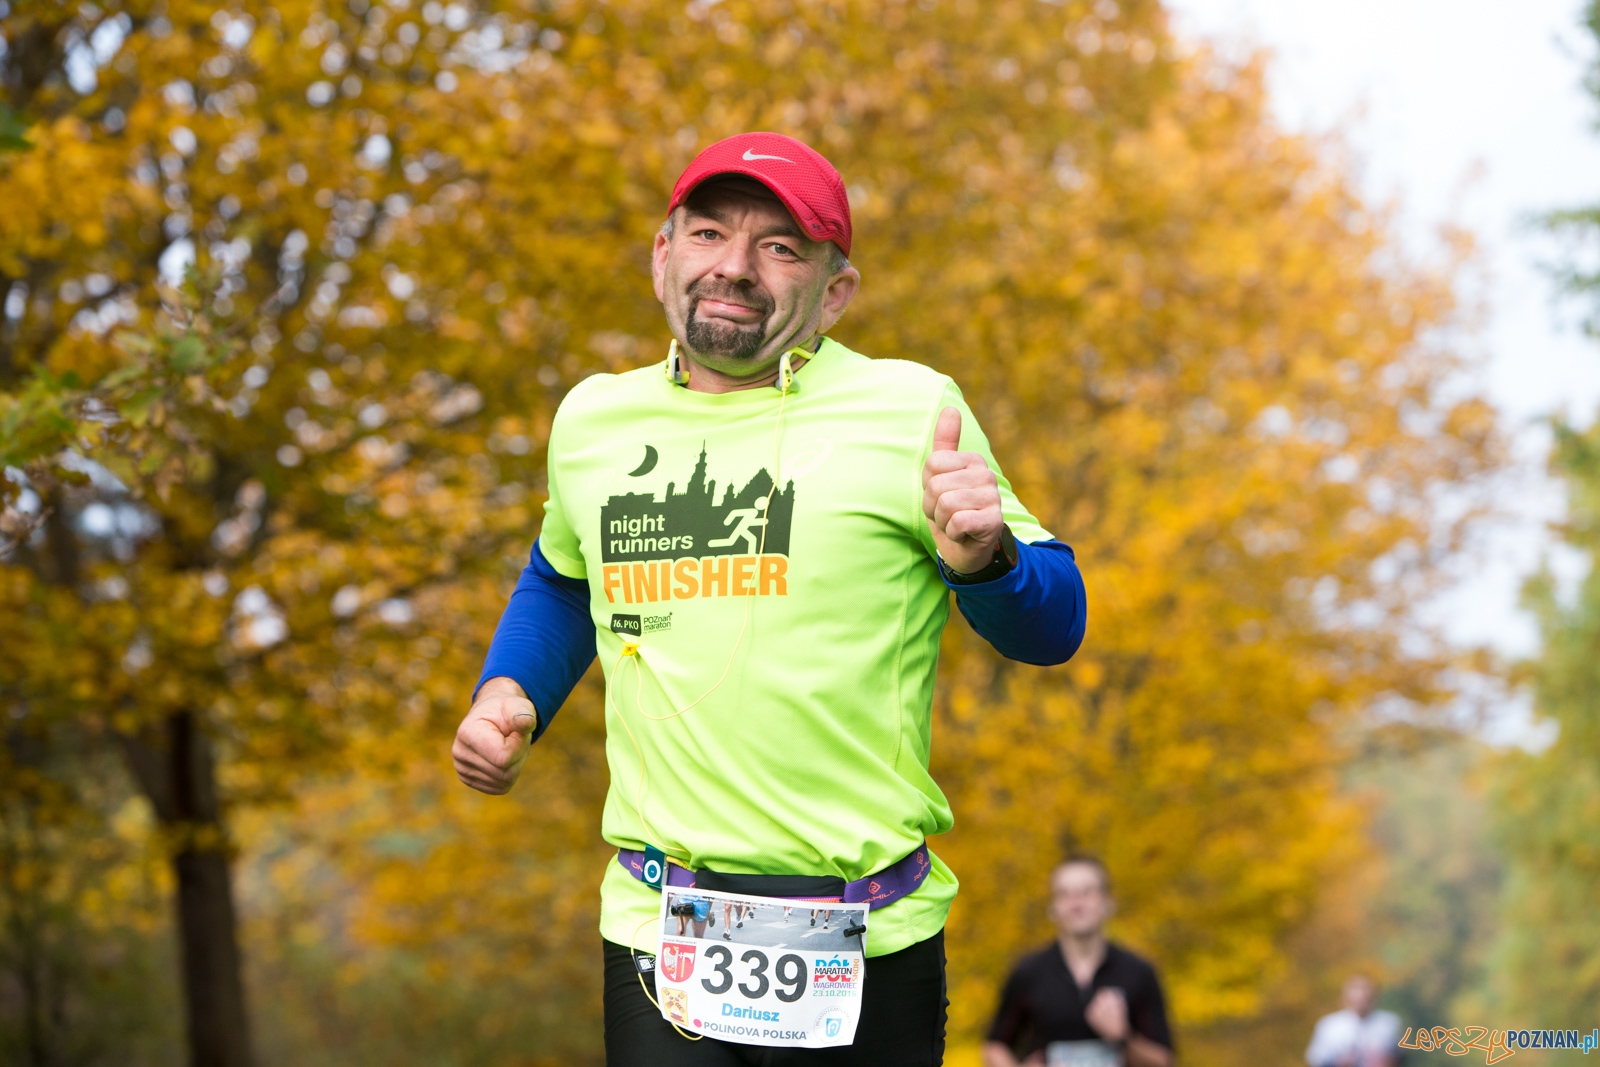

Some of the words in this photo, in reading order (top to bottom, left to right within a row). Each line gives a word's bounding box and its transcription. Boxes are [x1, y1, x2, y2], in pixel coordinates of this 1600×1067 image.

[610, 514, 666, 537] night
[610, 534, 694, 554] runners
[603, 556, 789, 604] FINISHER
[613, 619, 623, 628] 16.
[624, 619, 639, 631] PKO
[643, 621, 672, 632] maraton
[701, 944, 808, 1003] 339
[814, 967, 853, 975] MARATON
[812, 989, 857, 997] 23.10.2016
[721, 1002, 780, 1023] Dariusz
[703, 1021, 760, 1038] POLINOVA
[762, 1029, 808, 1041] POLSKA
